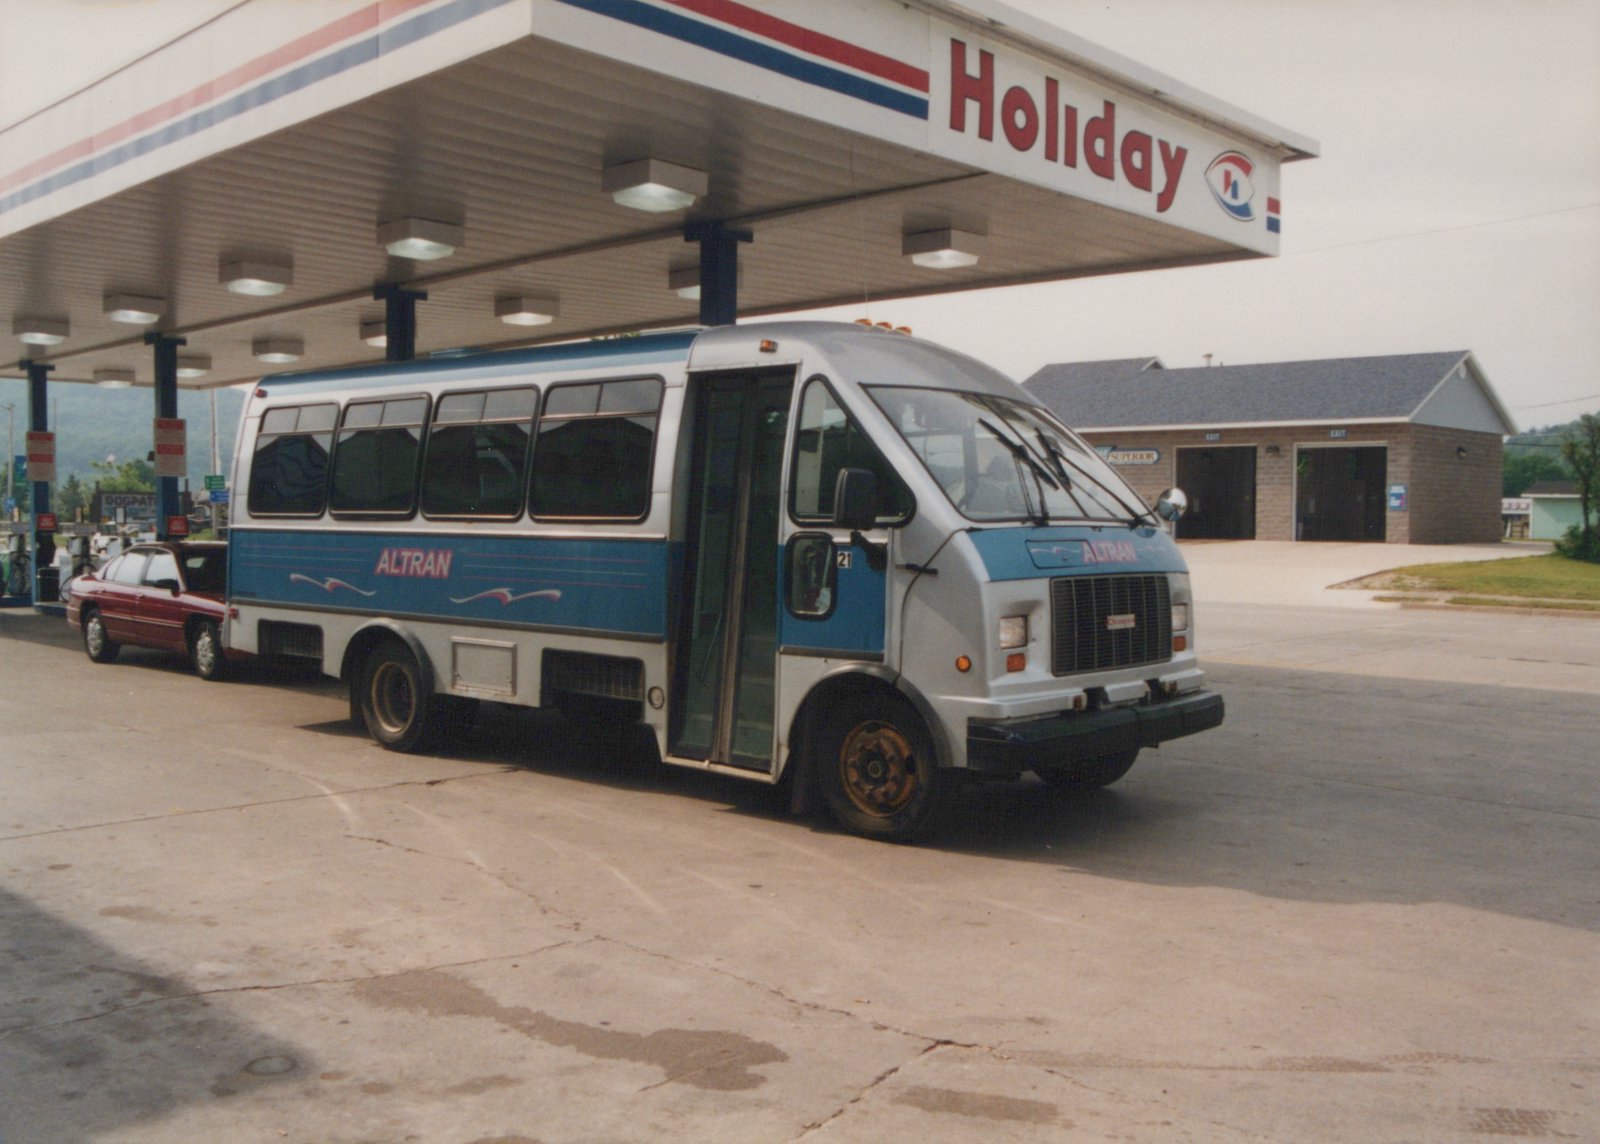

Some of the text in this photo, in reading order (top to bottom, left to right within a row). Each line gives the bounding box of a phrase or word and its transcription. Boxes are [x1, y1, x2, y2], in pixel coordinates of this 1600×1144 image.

[949, 38, 1188, 213] Holiday
[1110, 452, 1155, 461] SUPERIOR
[104, 495, 155, 506] DOGPAT
[838, 551, 851, 567] 21
[1081, 540, 1137, 564] ALTRAN
[374, 547, 453, 579] ALTRAN
